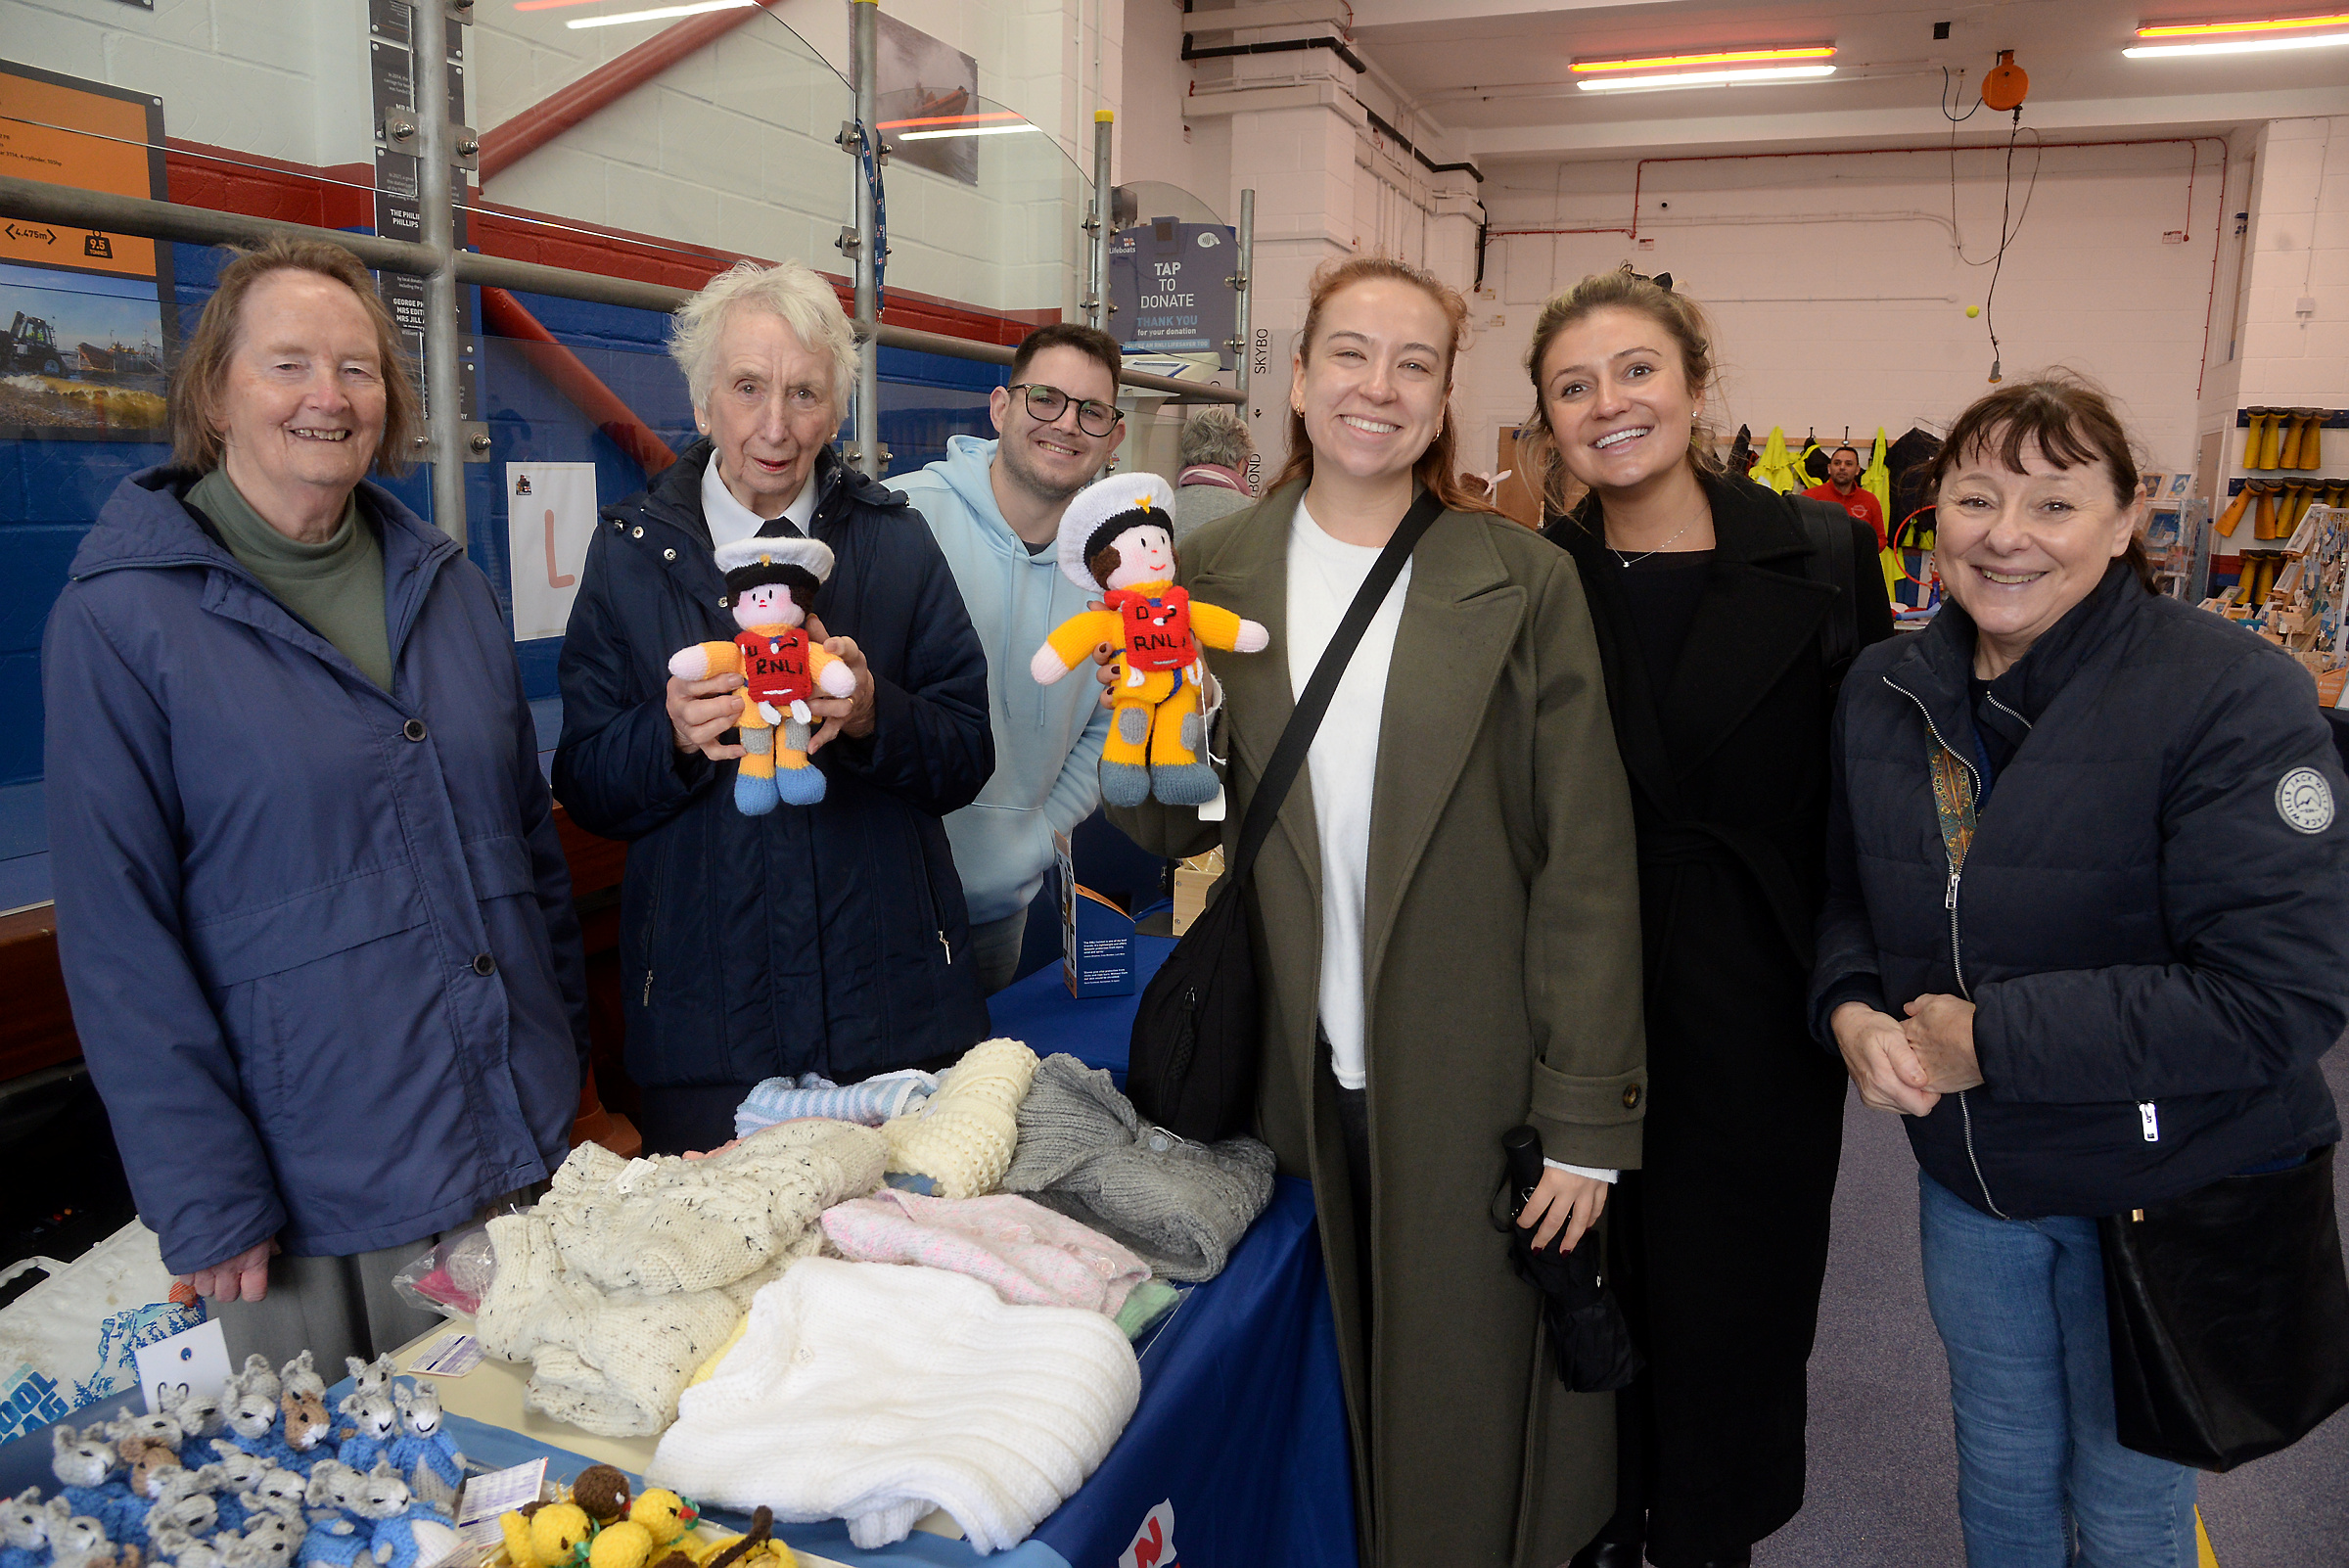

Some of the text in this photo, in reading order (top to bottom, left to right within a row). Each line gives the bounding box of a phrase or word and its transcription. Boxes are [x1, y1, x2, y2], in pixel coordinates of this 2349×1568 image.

[391, 208, 402, 217] THE
[392, 217, 419, 229] PHILLIPS
[16, 228, 48, 241] 4.475m
[89, 238, 106, 251] 9.5
[1154, 261, 1181, 276] TAP
[1158, 278, 1176, 292] TO
[393, 298, 416, 306] GEORGE
[1140, 294, 1195, 309] DONATE
[396, 306, 410, 315] MRS
[409, 315, 422, 324] JILL
[1137, 314, 1198, 327] THANK YOU
[1137, 327, 1196, 338] for your donation
[1254, 328, 1268, 375] SKYBO
[1248, 453, 1262, 497] BOND
[757, 658, 804, 675] RNLI
